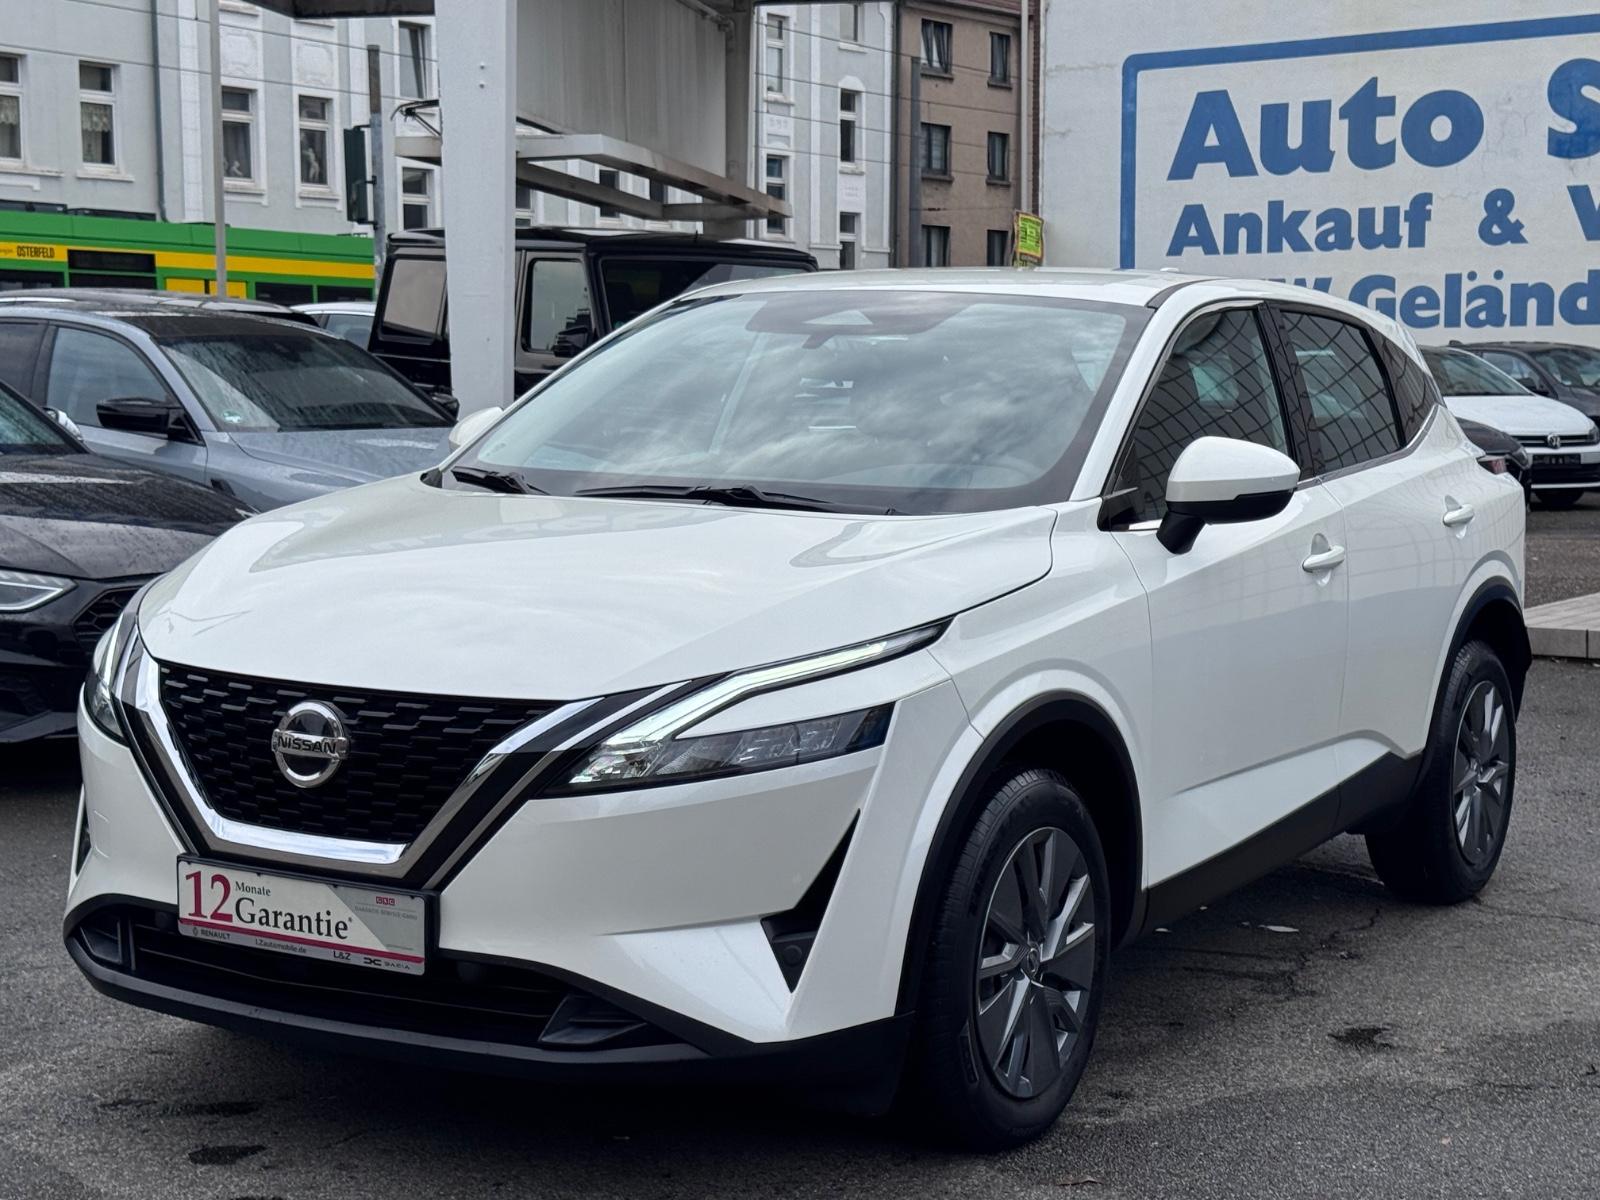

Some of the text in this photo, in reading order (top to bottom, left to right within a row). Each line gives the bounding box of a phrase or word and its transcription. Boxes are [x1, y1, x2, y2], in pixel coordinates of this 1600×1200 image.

[1167, 77, 1484, 181] Auto
[1167, 192, 1433, 257] Ankauf
[1478, 188, 1528, 246] &
[277, 735, 337, 753] NISSAN
[185, 870, 234, 923] 12
[235, 880, 271, 897] Monate
[200, 928, 231, 940] RENAULT
[332, 950, 352, 961] L&Z
